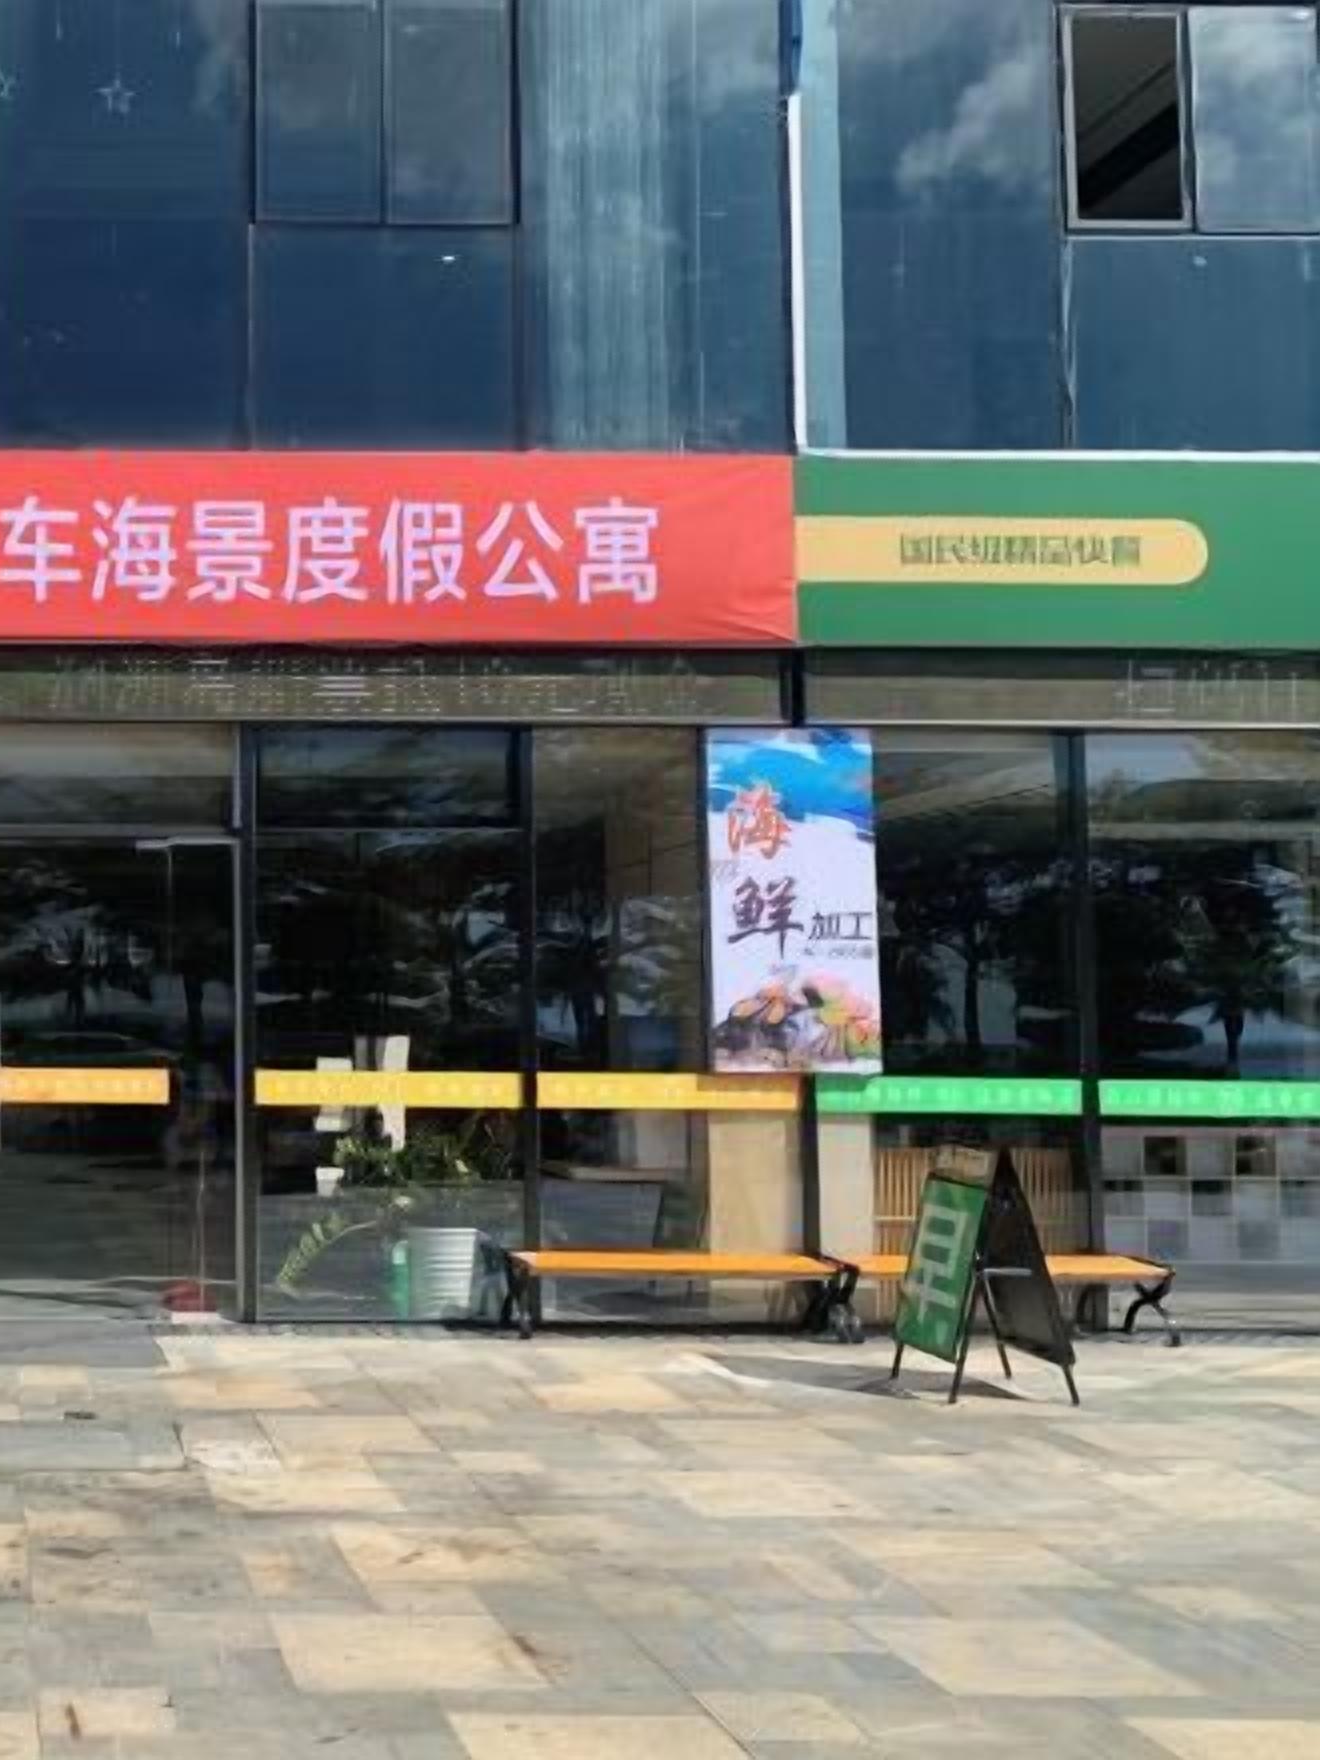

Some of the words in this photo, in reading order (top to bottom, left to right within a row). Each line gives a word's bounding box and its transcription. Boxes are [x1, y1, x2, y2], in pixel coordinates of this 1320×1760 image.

[900, 535, 1141, 566] 国民级精品快
[808, 911, 872, 941] 加工
